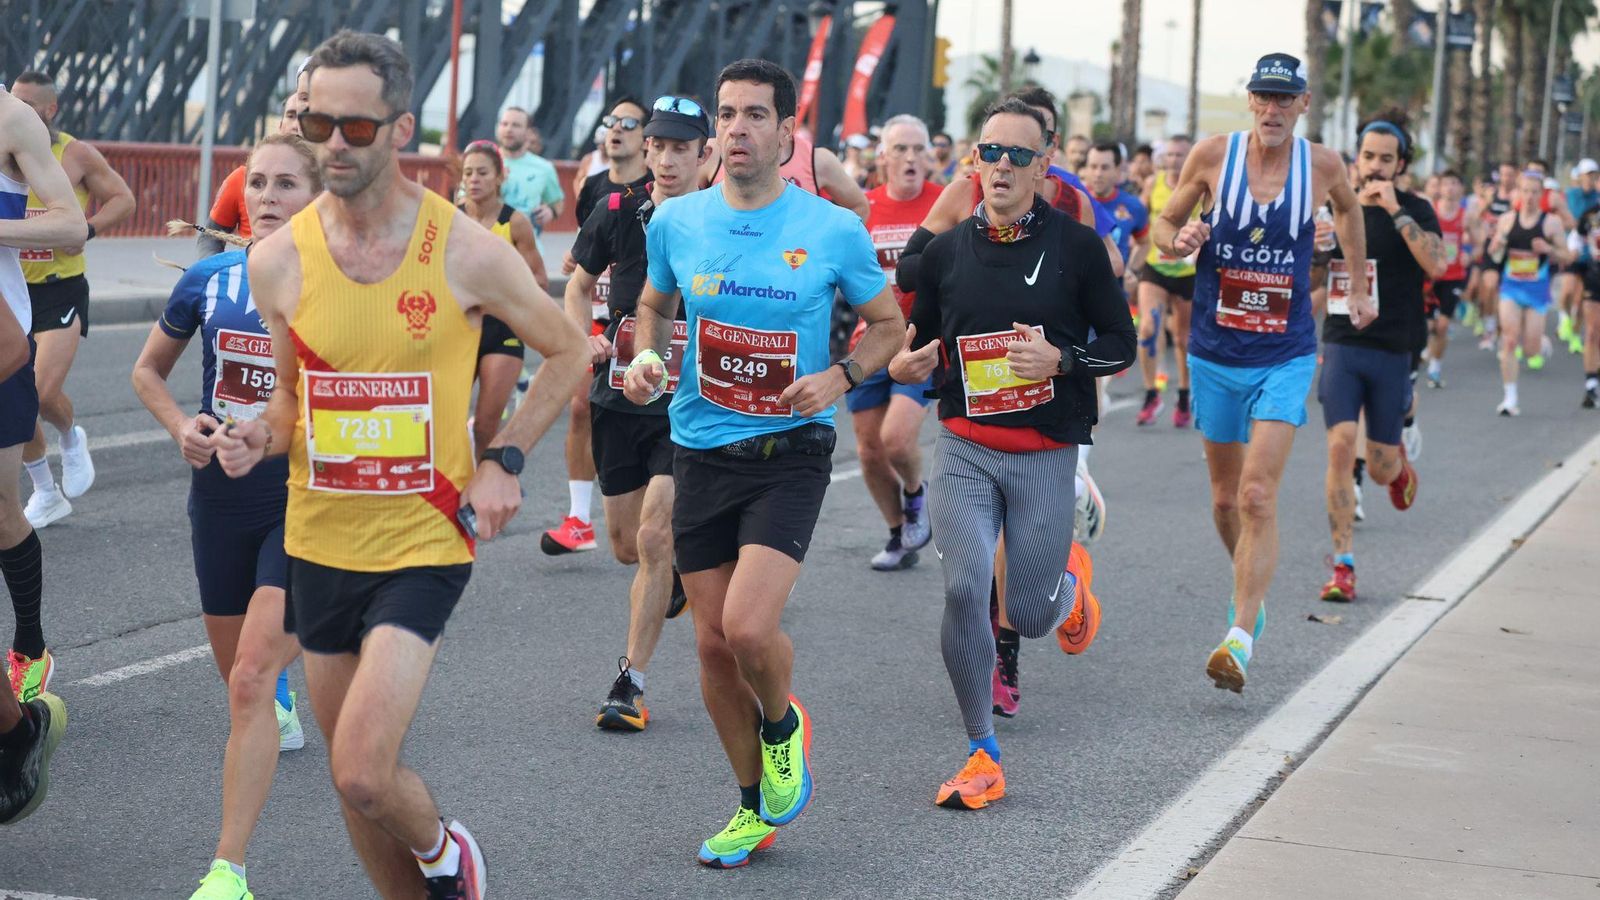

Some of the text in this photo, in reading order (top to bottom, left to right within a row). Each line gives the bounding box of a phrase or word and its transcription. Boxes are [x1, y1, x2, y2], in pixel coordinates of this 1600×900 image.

[418, 219, 438, 265] soar
[1215, 242, 1296, 265] IS GÖTA
[1240, 270, 1290, 286] GENERALI
[1241, 290, 1268, 305] 833
[723, 329, 790, 348] GENERALI
[720, 355, 768, 378] 6249
[335, 380, 420, 397] GENERALI
[733, 375, 753, 384] JULIO
[336, 417, 394, 439] 7281
